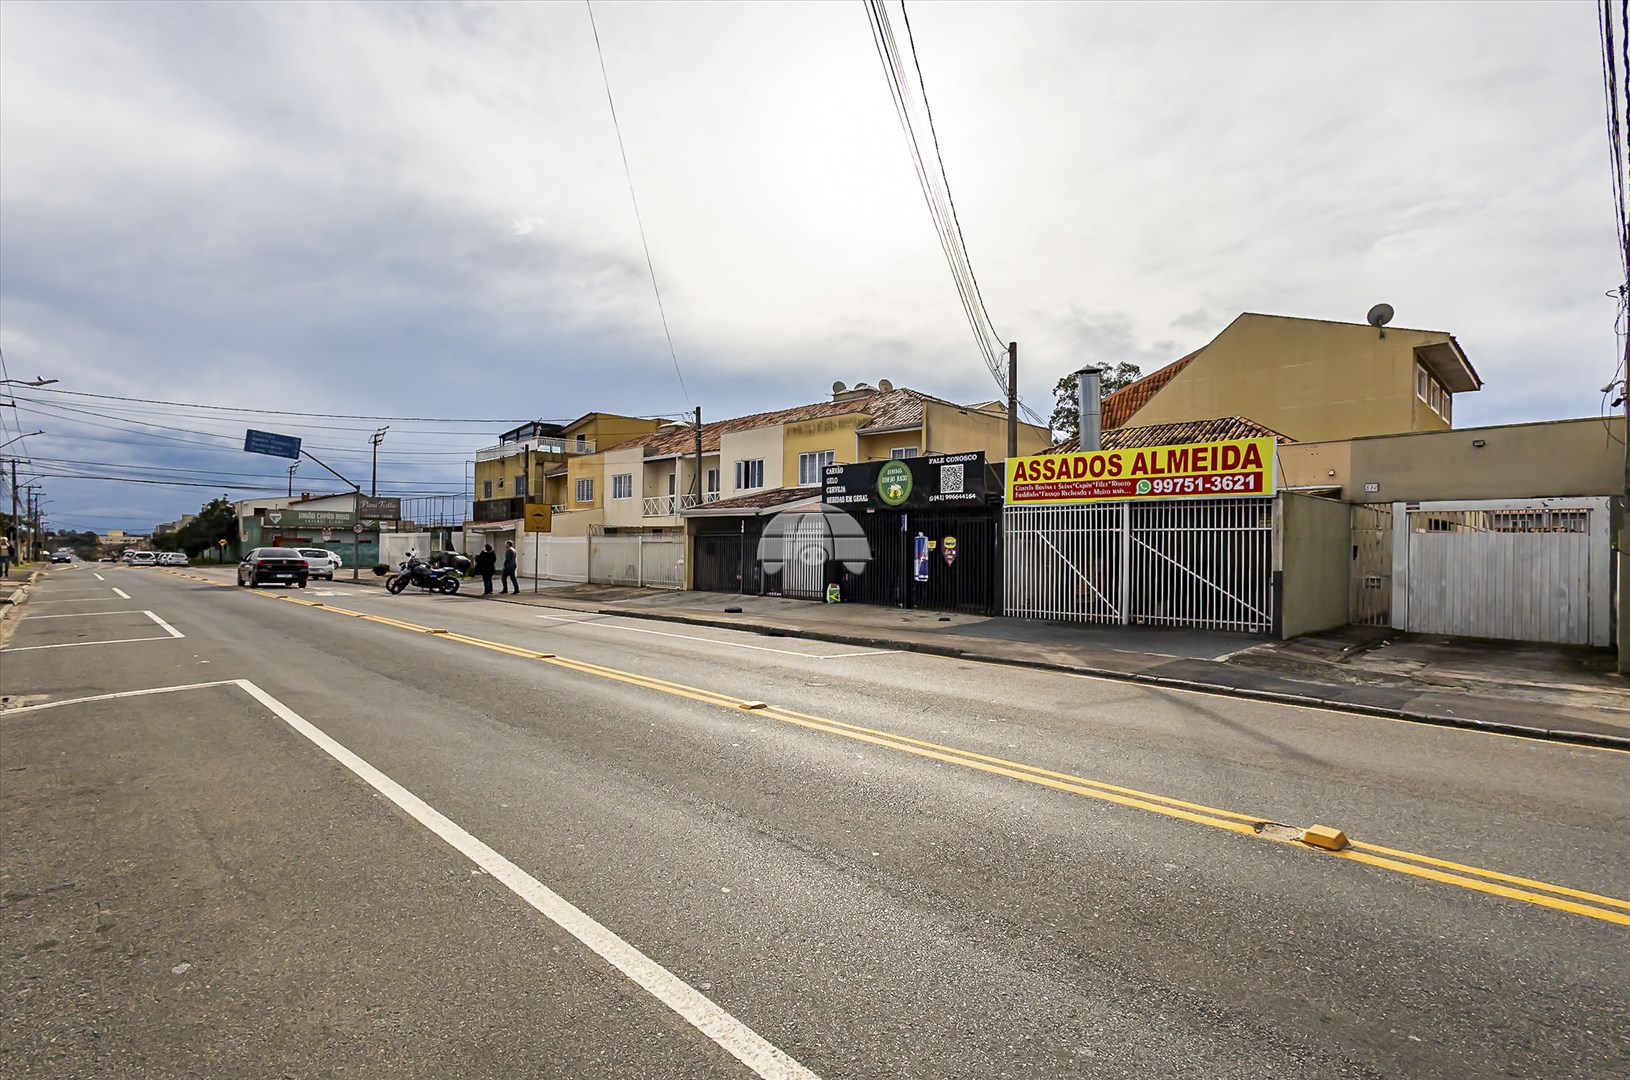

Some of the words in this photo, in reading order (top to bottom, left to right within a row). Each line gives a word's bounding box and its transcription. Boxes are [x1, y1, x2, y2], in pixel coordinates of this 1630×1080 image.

[945, 454, 978, 463] CONOSCO
[1013, 453, 1123, 482] ASSADOS
[1131, 443, 1264, 475] ALMEIDA
[826, 466, 844, 475] CARVÃO
[1153, 474, 1255, 494] 99751-3621
[826, 485, 846, 494] CERVEJA
[826, 496, 845, 504] BEBIDAS
[845, 495, 853, 503] EM
[853, 494, 869, 502] GERAL
